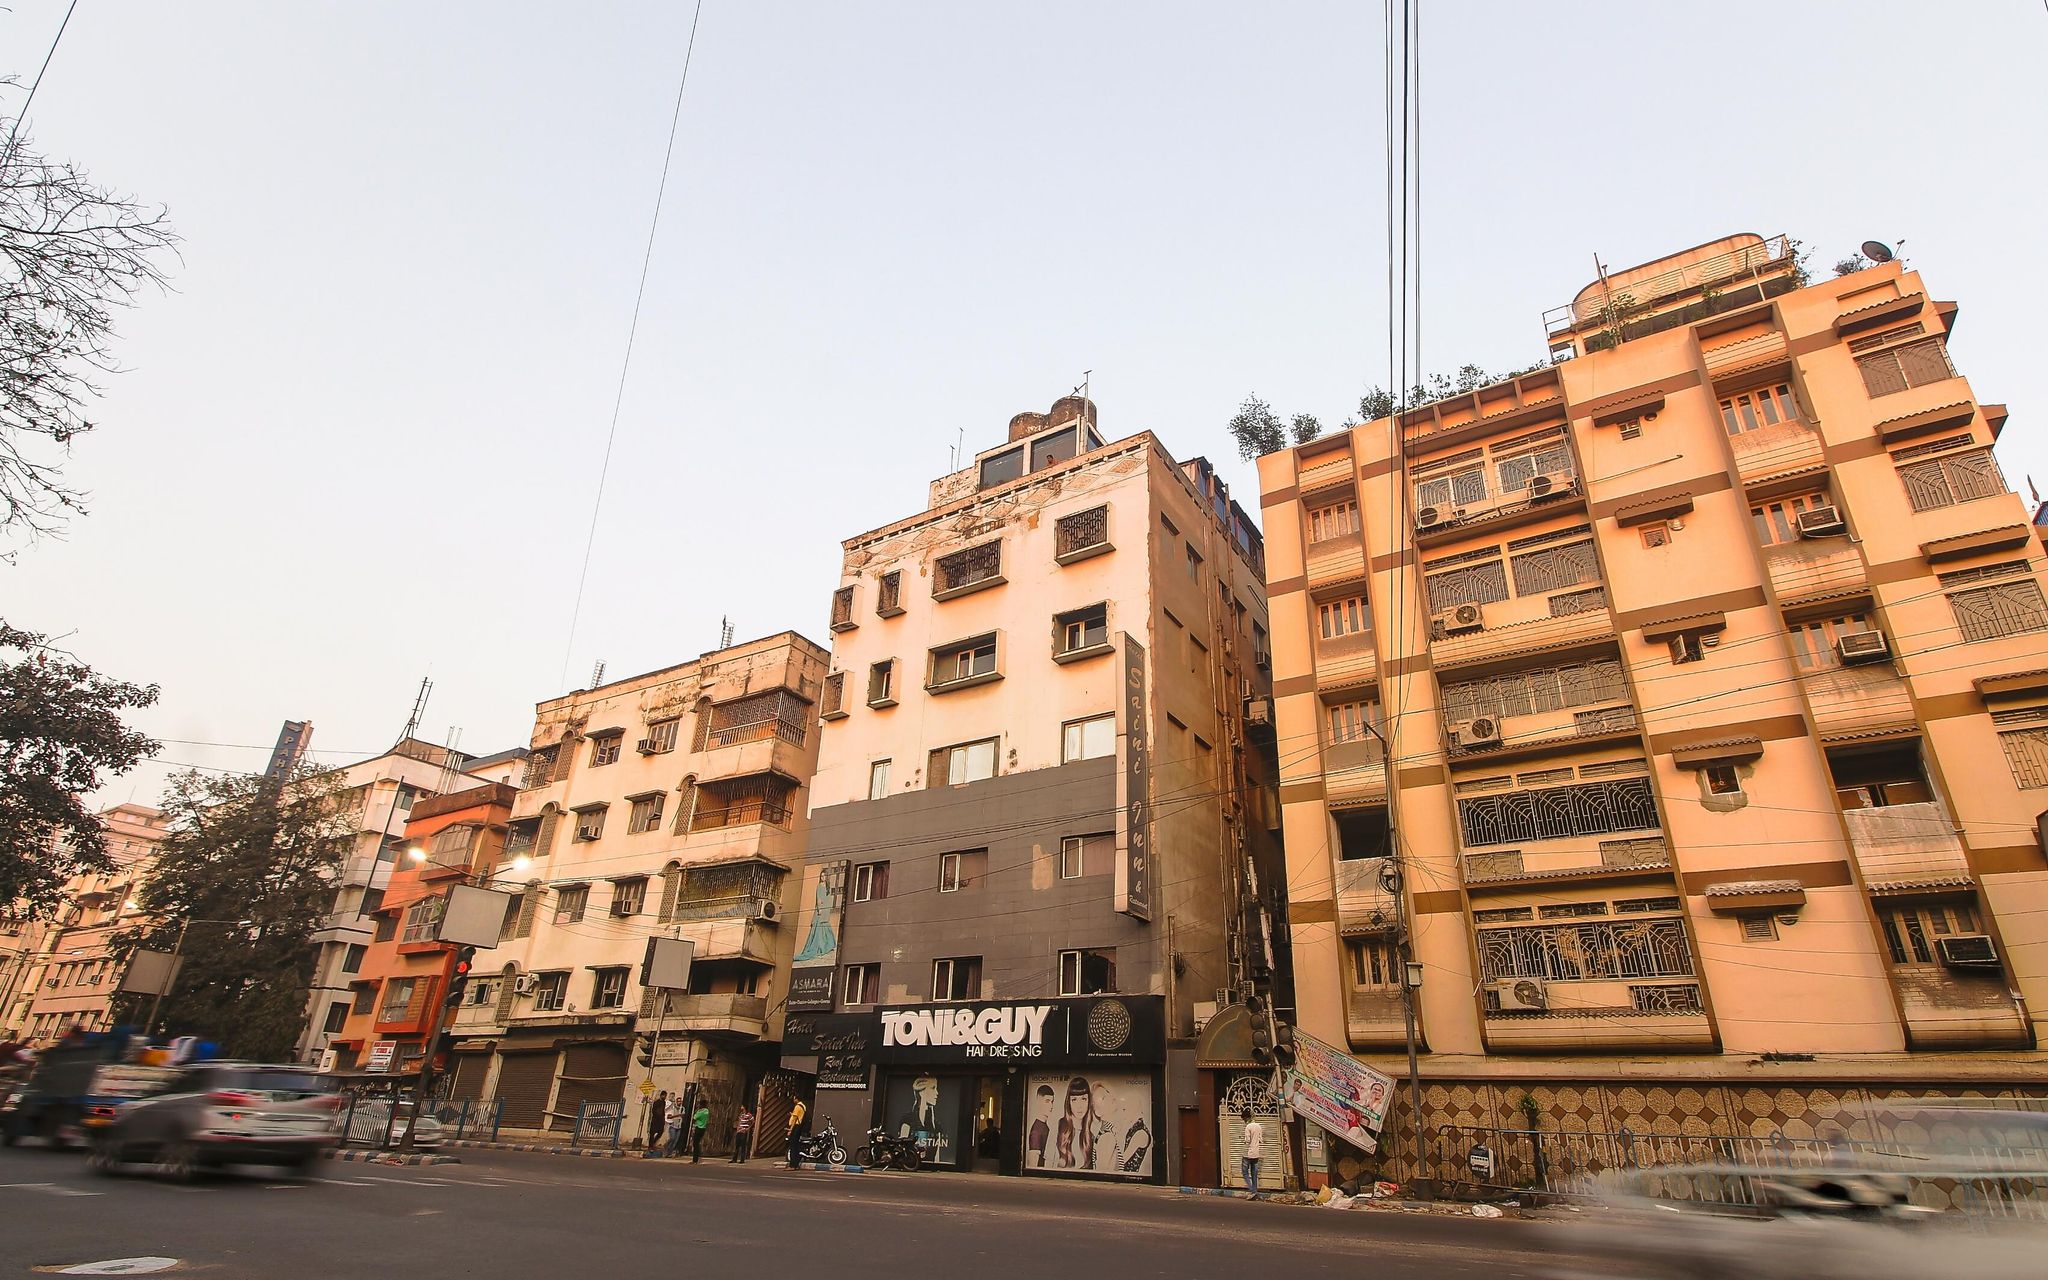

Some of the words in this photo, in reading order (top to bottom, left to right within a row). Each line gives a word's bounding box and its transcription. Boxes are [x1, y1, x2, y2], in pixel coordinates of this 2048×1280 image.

[787, 1019, 817, 1034] Hotel
[881, 1006, 1051, 1046] TONI&GUY
[966, 1045, 1042, 1057] HAIDRESNG
[914, 1138, 949, 1147] ASTIAN
